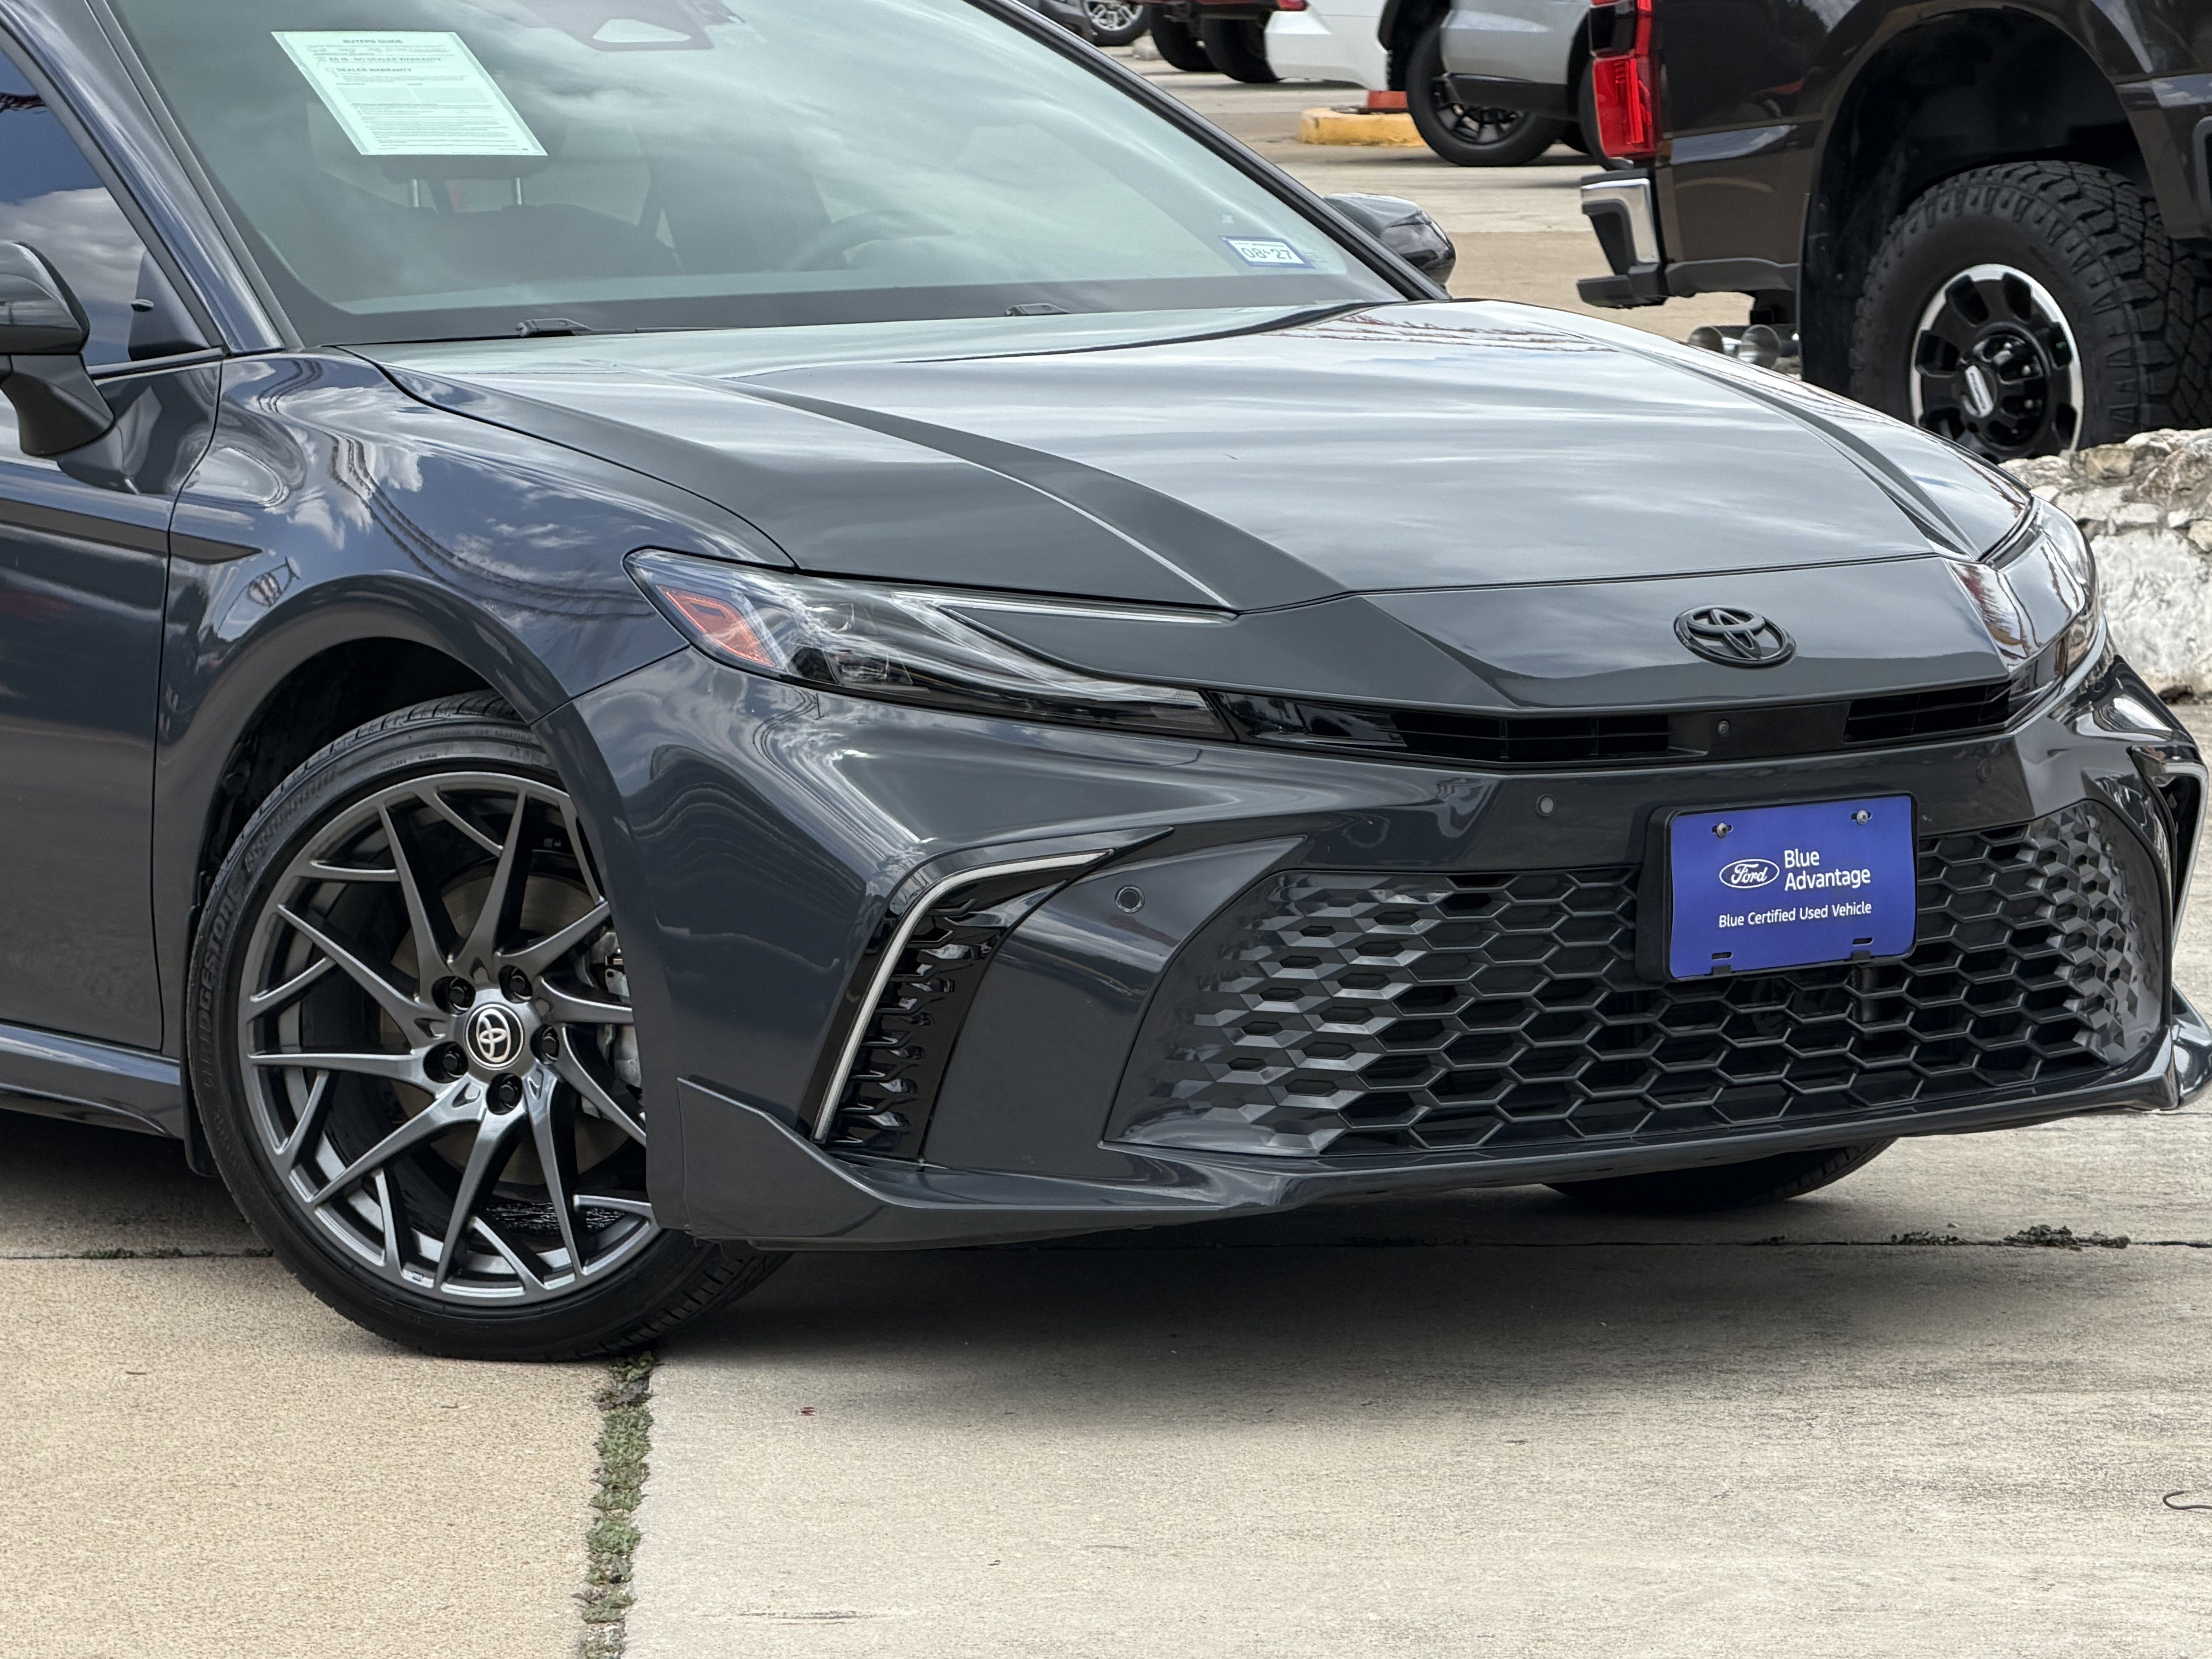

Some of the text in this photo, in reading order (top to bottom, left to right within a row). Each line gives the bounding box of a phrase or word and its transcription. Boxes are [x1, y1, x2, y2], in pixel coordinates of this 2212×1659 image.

[1784, 848, 1820, 868] Blue
[1731, 863, 1768, 884] Ford
[1784, 869, 1871, 891] Advantage
[1719, 901, 1872, 928] Blue Certified Used Vehicle
